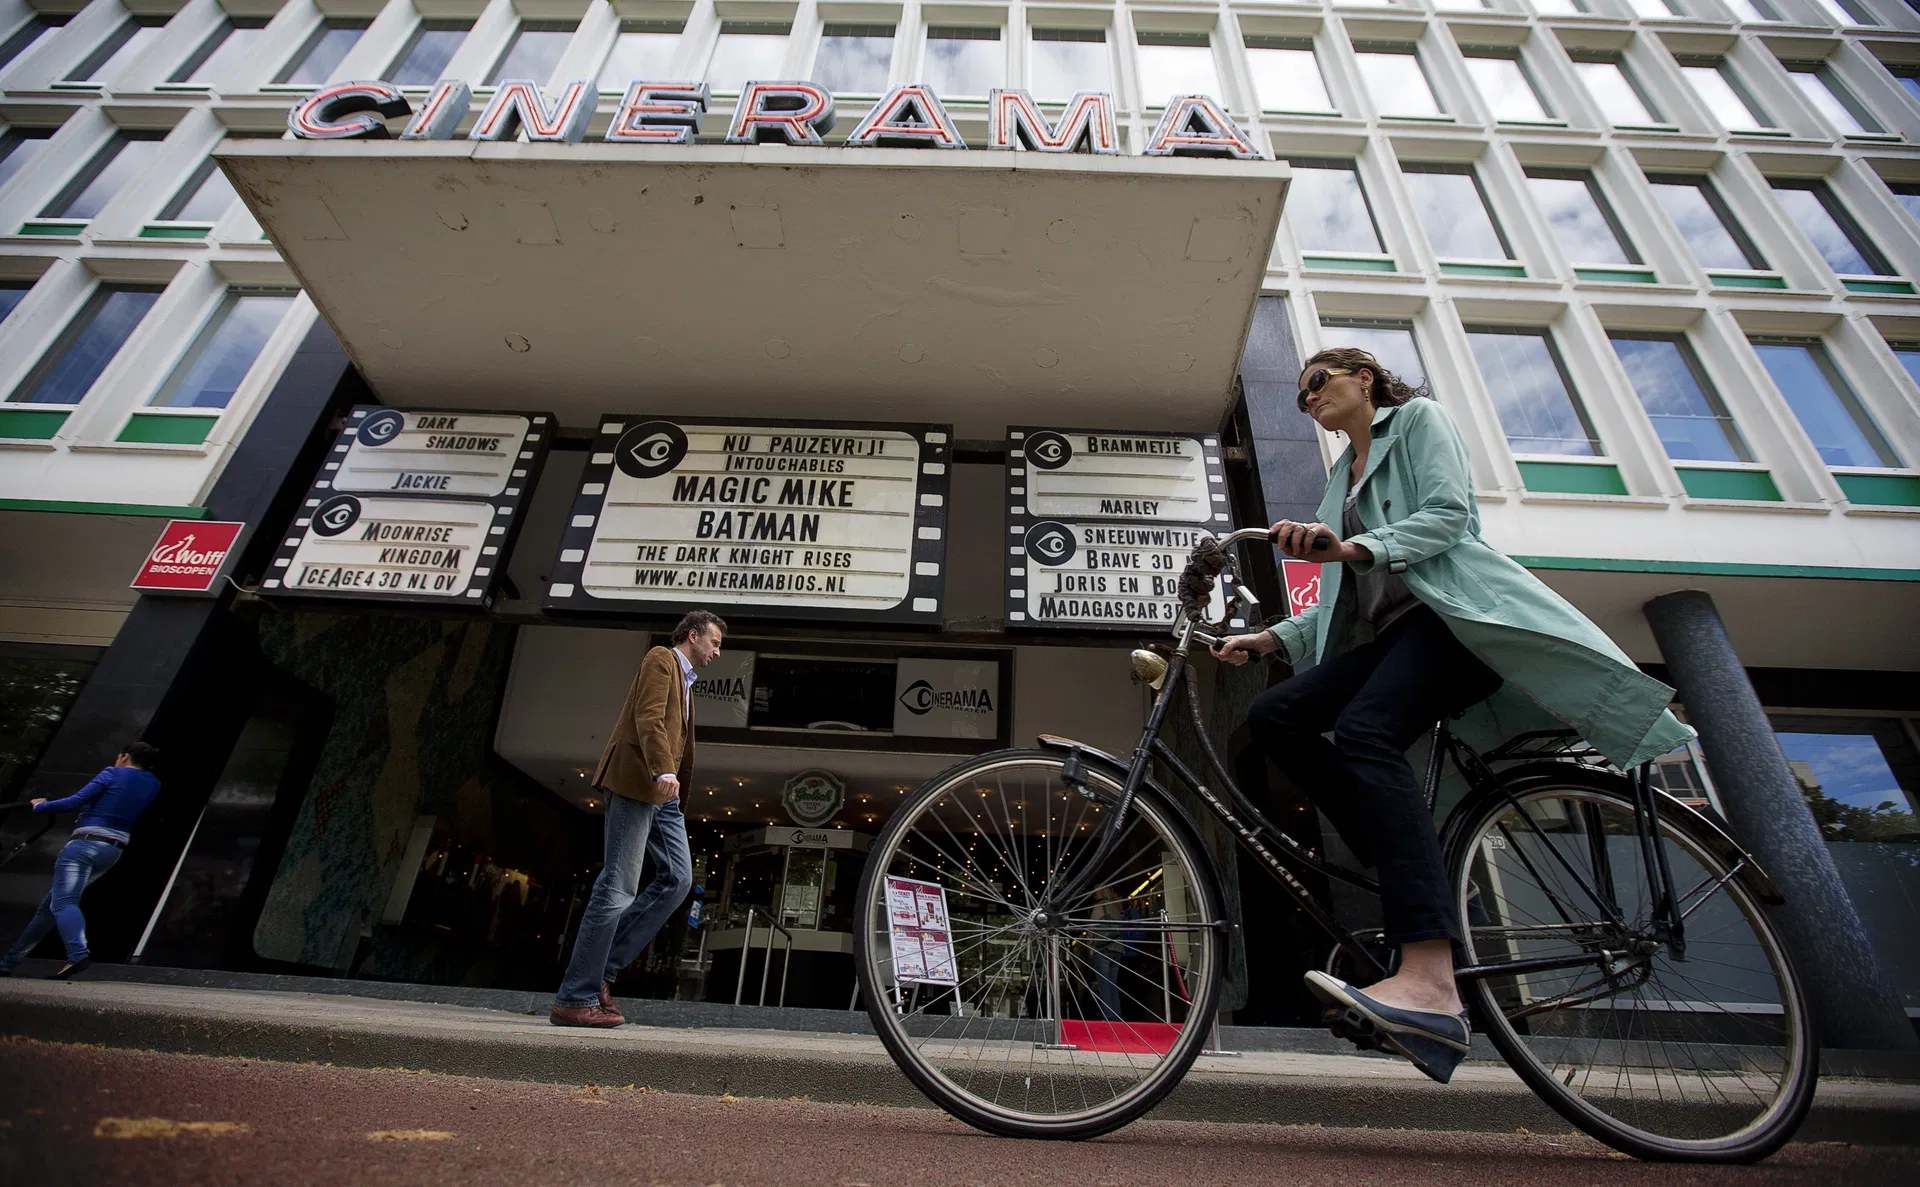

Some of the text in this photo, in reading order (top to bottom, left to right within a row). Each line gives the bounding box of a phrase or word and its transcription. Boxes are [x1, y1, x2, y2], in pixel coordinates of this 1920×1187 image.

[286, 78, 1265, 160] CINERAMA
[416, 416, 459, 430] DARK
[426, 435, 500, 451] SHADOWS
[723, 435, 751, 452] NU
[1088, 436, 1182, 455] BRAMMETJE
[725, 454, 844, 473] INTOUCHABLES
[391, 473, 451, 490] JACKIE
[672, 475, 855, 507] MAGIC MIKE
[1100, 500, 1159, 515] MARLEY
[360, 522, 453, 543] MOONRISE
[696, 511, 820, 542] BATMAN
[1085, 528, 1199, 547] SNEEUWWITJE
[174, 550, 225, 565] Wolff
[378, 548, 461, 569] KINGDOM
[637, 546, 851, 568] THE DARK KNIGHT RISES
[1087, 550, 1140, 569] BRAVE
[1152, 554, 1173, 570] 3D
[149, 565, 215, 576] BIOSCOPEN
[378, 572, 402, 589] 3D
[407, 573, 427, 589] NL
[433, 575, 458, 590] OV
[635, 569, 846, 593] WWW.CINERAMABIOS.NL
[1054, 573, 1176, 596] JORIS EN BO
[1039, 597, 1158, 619] MADAGASCAR
[917, 688, 993, 711] CINERAMA
[936, 705, 987, 715] FILMTHEATER
